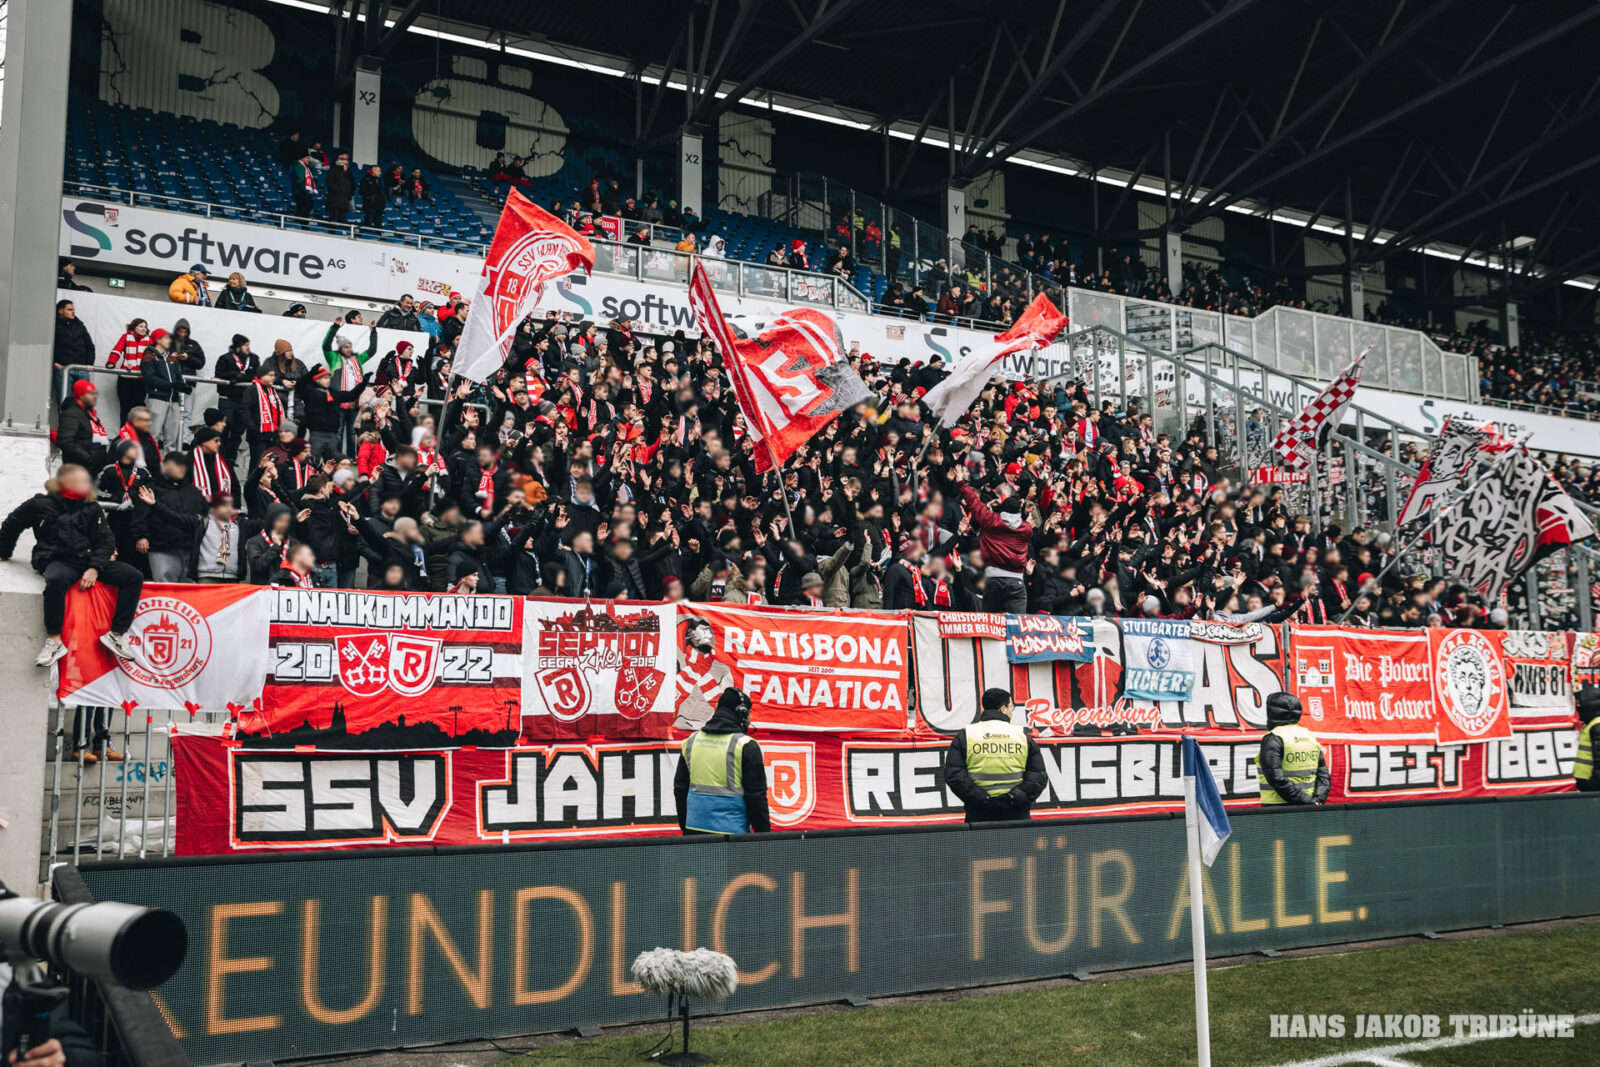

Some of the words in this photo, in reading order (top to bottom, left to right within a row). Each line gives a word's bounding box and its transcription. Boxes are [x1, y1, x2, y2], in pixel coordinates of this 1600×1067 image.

[359, 90, 376, 103] X2
[685, 153, 699, 165] X2
[124, 228, 324, 279] software
[327, 257, 347, 269] AG
[518, 248, 536, 271] SSV
[506, 277, 518, 294] 18
[136, 598, 202, 625] anclub
[940, 612, 989, 624] CHRISTOPH
[990, 613, 1007, 625] FÜR
[941, 624, 974, 634] IMMER
[977, 624, 989, 634] BEI
[990, 625, 1007, 637] UNS
[1123, 620, 1191, 638] STUTTGARTER
[128, 635, 142, 647] 20
[180, 638, 193, 649] 21
[539, 632, 660, 656] SEKTION
[723, 626, 903, 666] RATISBONA
[275, 643, 333, 681] 20
[442, 647, 493, 683] 22
[630, 656, 656, 668] 2019
[1343, 652, 1373, 683] Die
[1378, 655, 1430, 688] Power
[742, 673, 903, 711] FANATICA
[1126, 669, 1194, 692] KICKERS
[1550, 665, 1566, 697] 81
[1025, 696, 1162, 735] Regensburg
[1344, 694, 1377, 720] vom
[1378, 692, 1433, 721] Tower
[972, 742, 1023, 755] ORDNER
[241, 759, 437, 833] SSV
[851, 743, 1261, 811] RENSBURG
[1350, 745, 1464, 787] SEIT
[1488, 731, 1578, 780] 1889
[150, 867, 860, 1038] EUNDLICH
[969, 836, 1141, 962] FÜR
[1167, 834, 1370, 942] ALLE.
